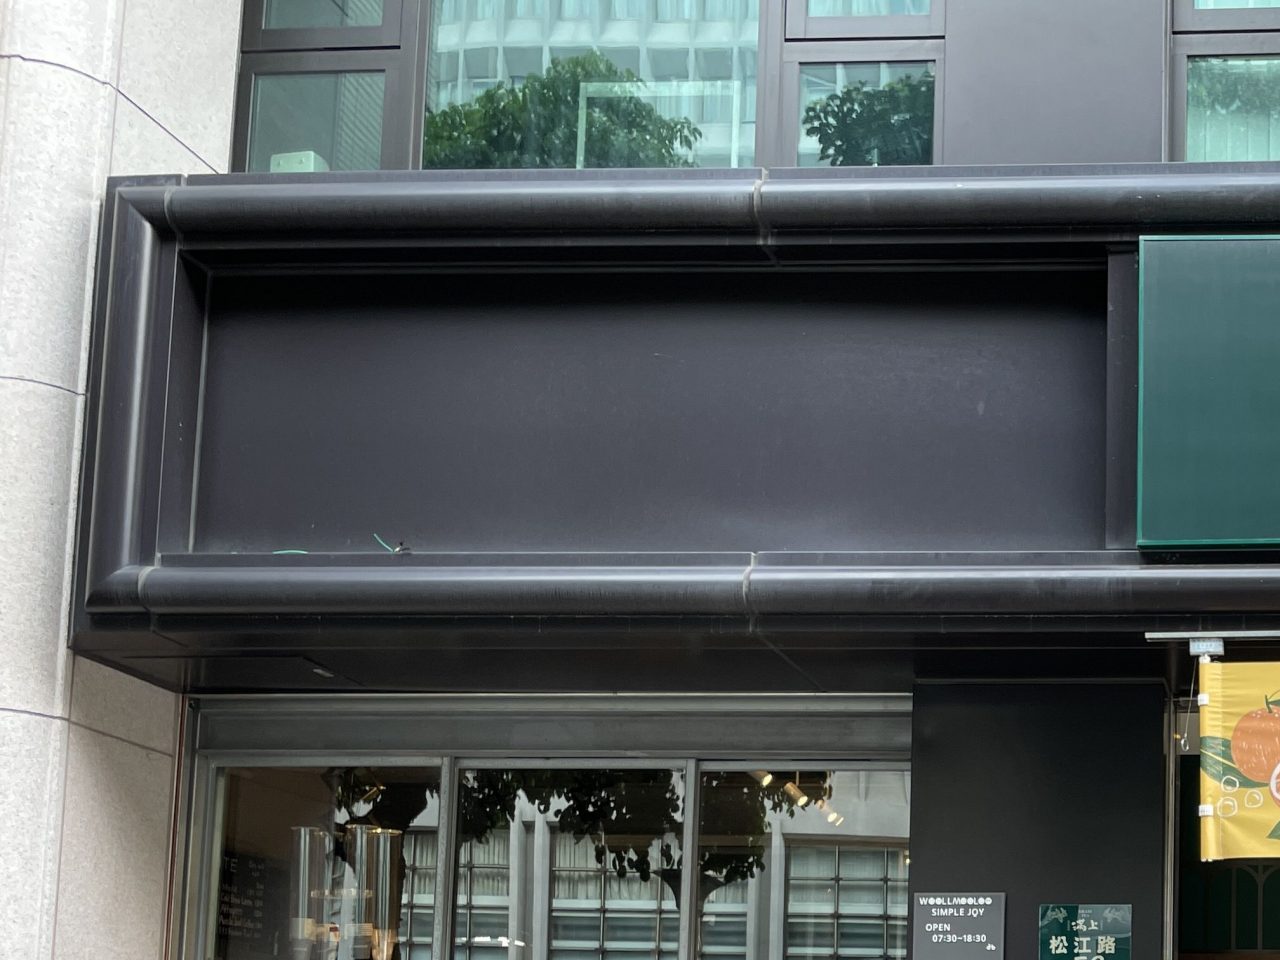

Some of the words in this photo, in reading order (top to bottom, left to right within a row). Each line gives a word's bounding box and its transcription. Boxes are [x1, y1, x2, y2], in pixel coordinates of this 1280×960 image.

[931, 908, 964, 916] SIMPLE
[925, 923, 951, 931] OPEN
[1049, 936, 1116, 954] 松江路
